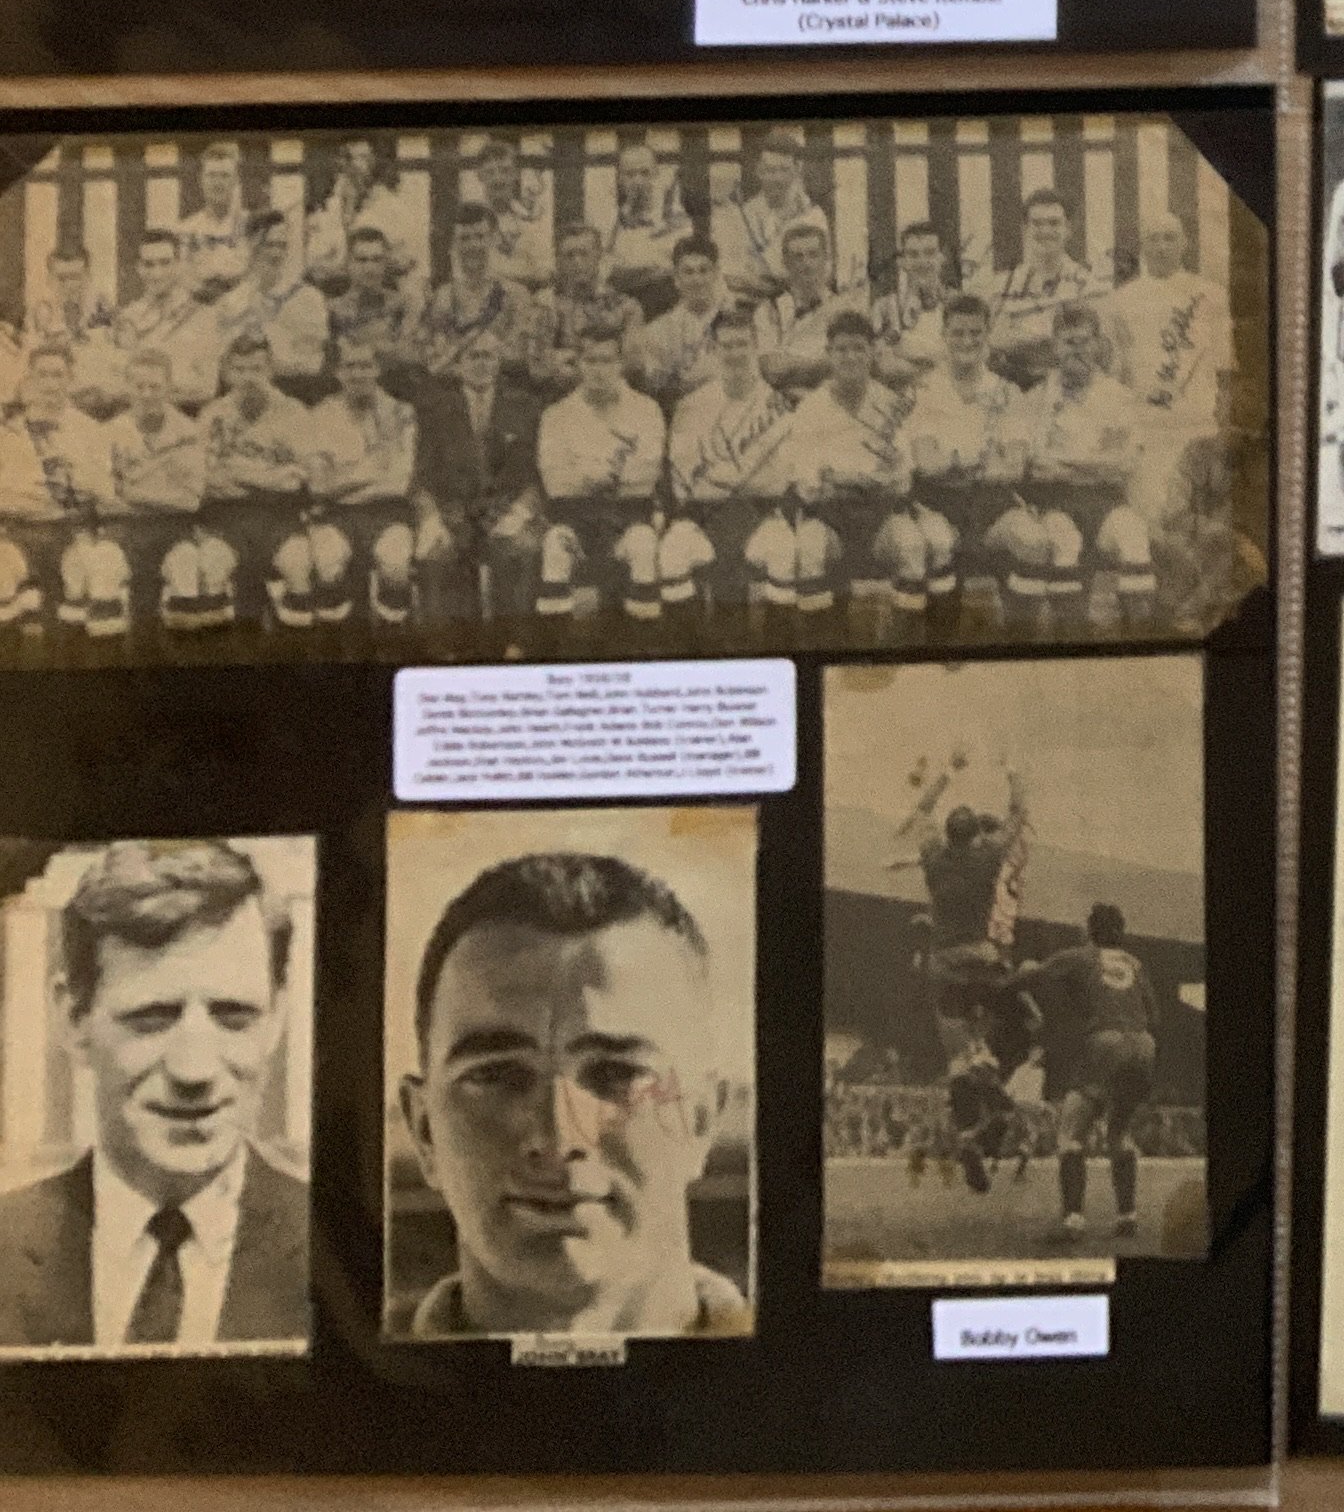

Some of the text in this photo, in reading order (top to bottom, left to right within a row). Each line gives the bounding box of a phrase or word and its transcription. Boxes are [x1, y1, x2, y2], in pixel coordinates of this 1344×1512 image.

[798, 10, 941, 33] (Crystal Palace)
[959, 1326, 1078, 1349] Bobby Owen
